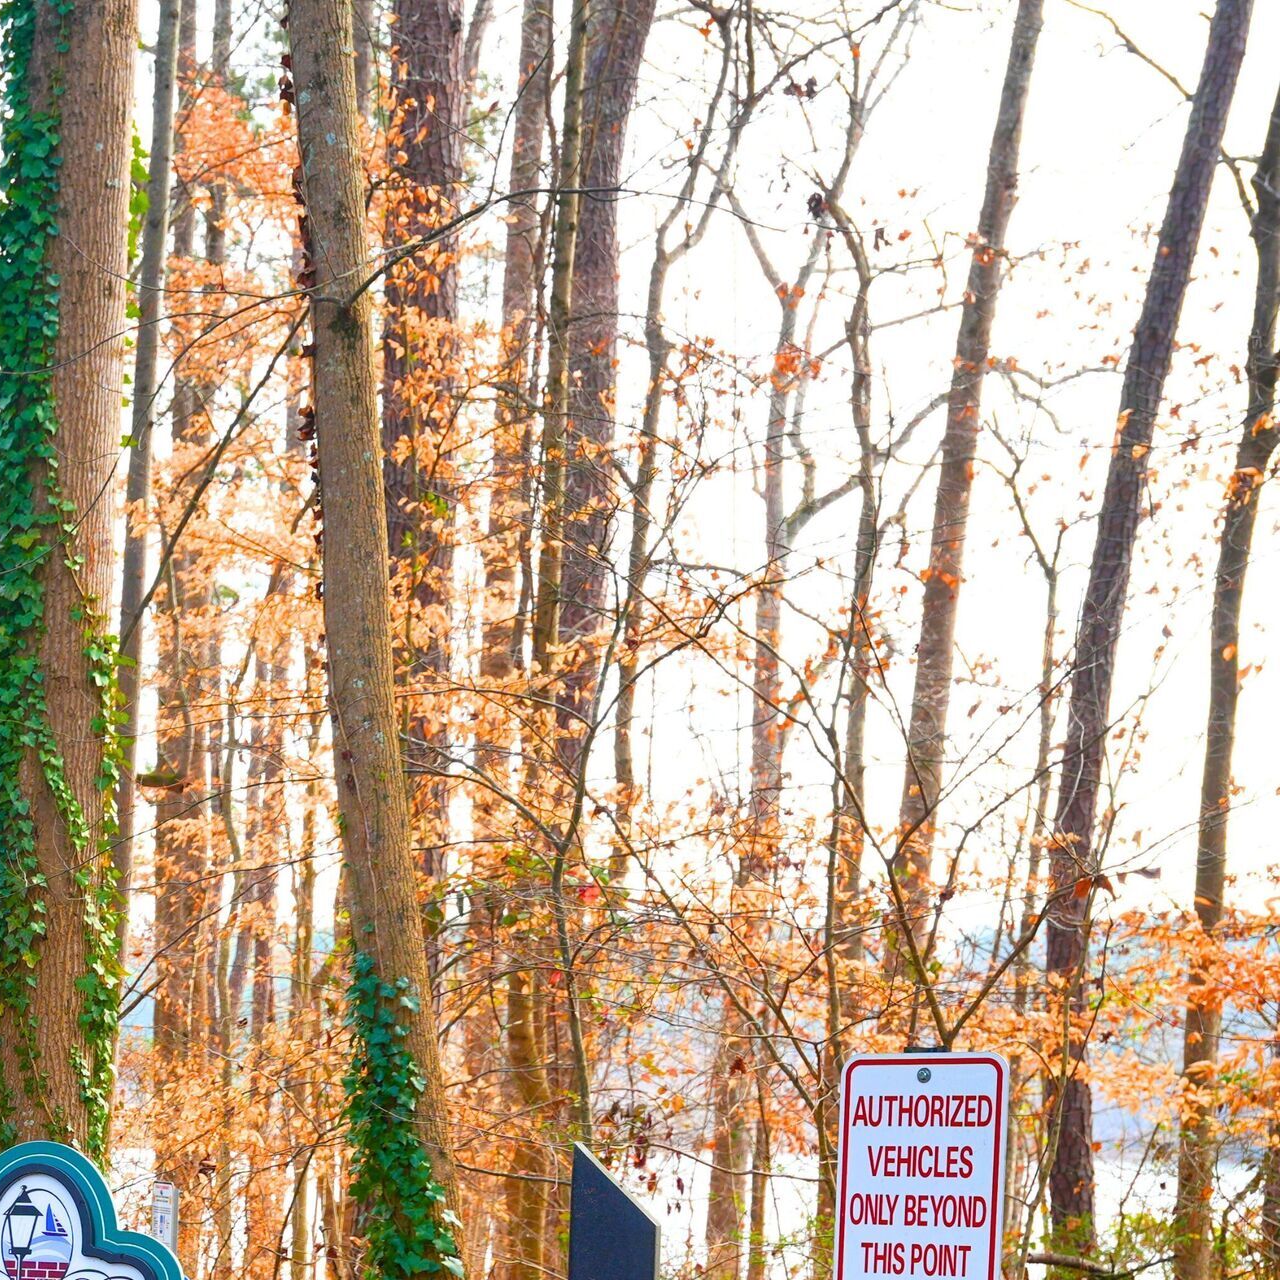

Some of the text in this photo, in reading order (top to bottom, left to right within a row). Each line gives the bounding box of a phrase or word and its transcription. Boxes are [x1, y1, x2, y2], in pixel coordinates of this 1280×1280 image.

[852, 1094, 992, 1127] AUTHORIZED
[868, 1146, 973, 1178] VEHICLES
[850, 1193, 986, 1227] ONLY BEYOND
[861, 1243, 971, 1277] THIS POINT
